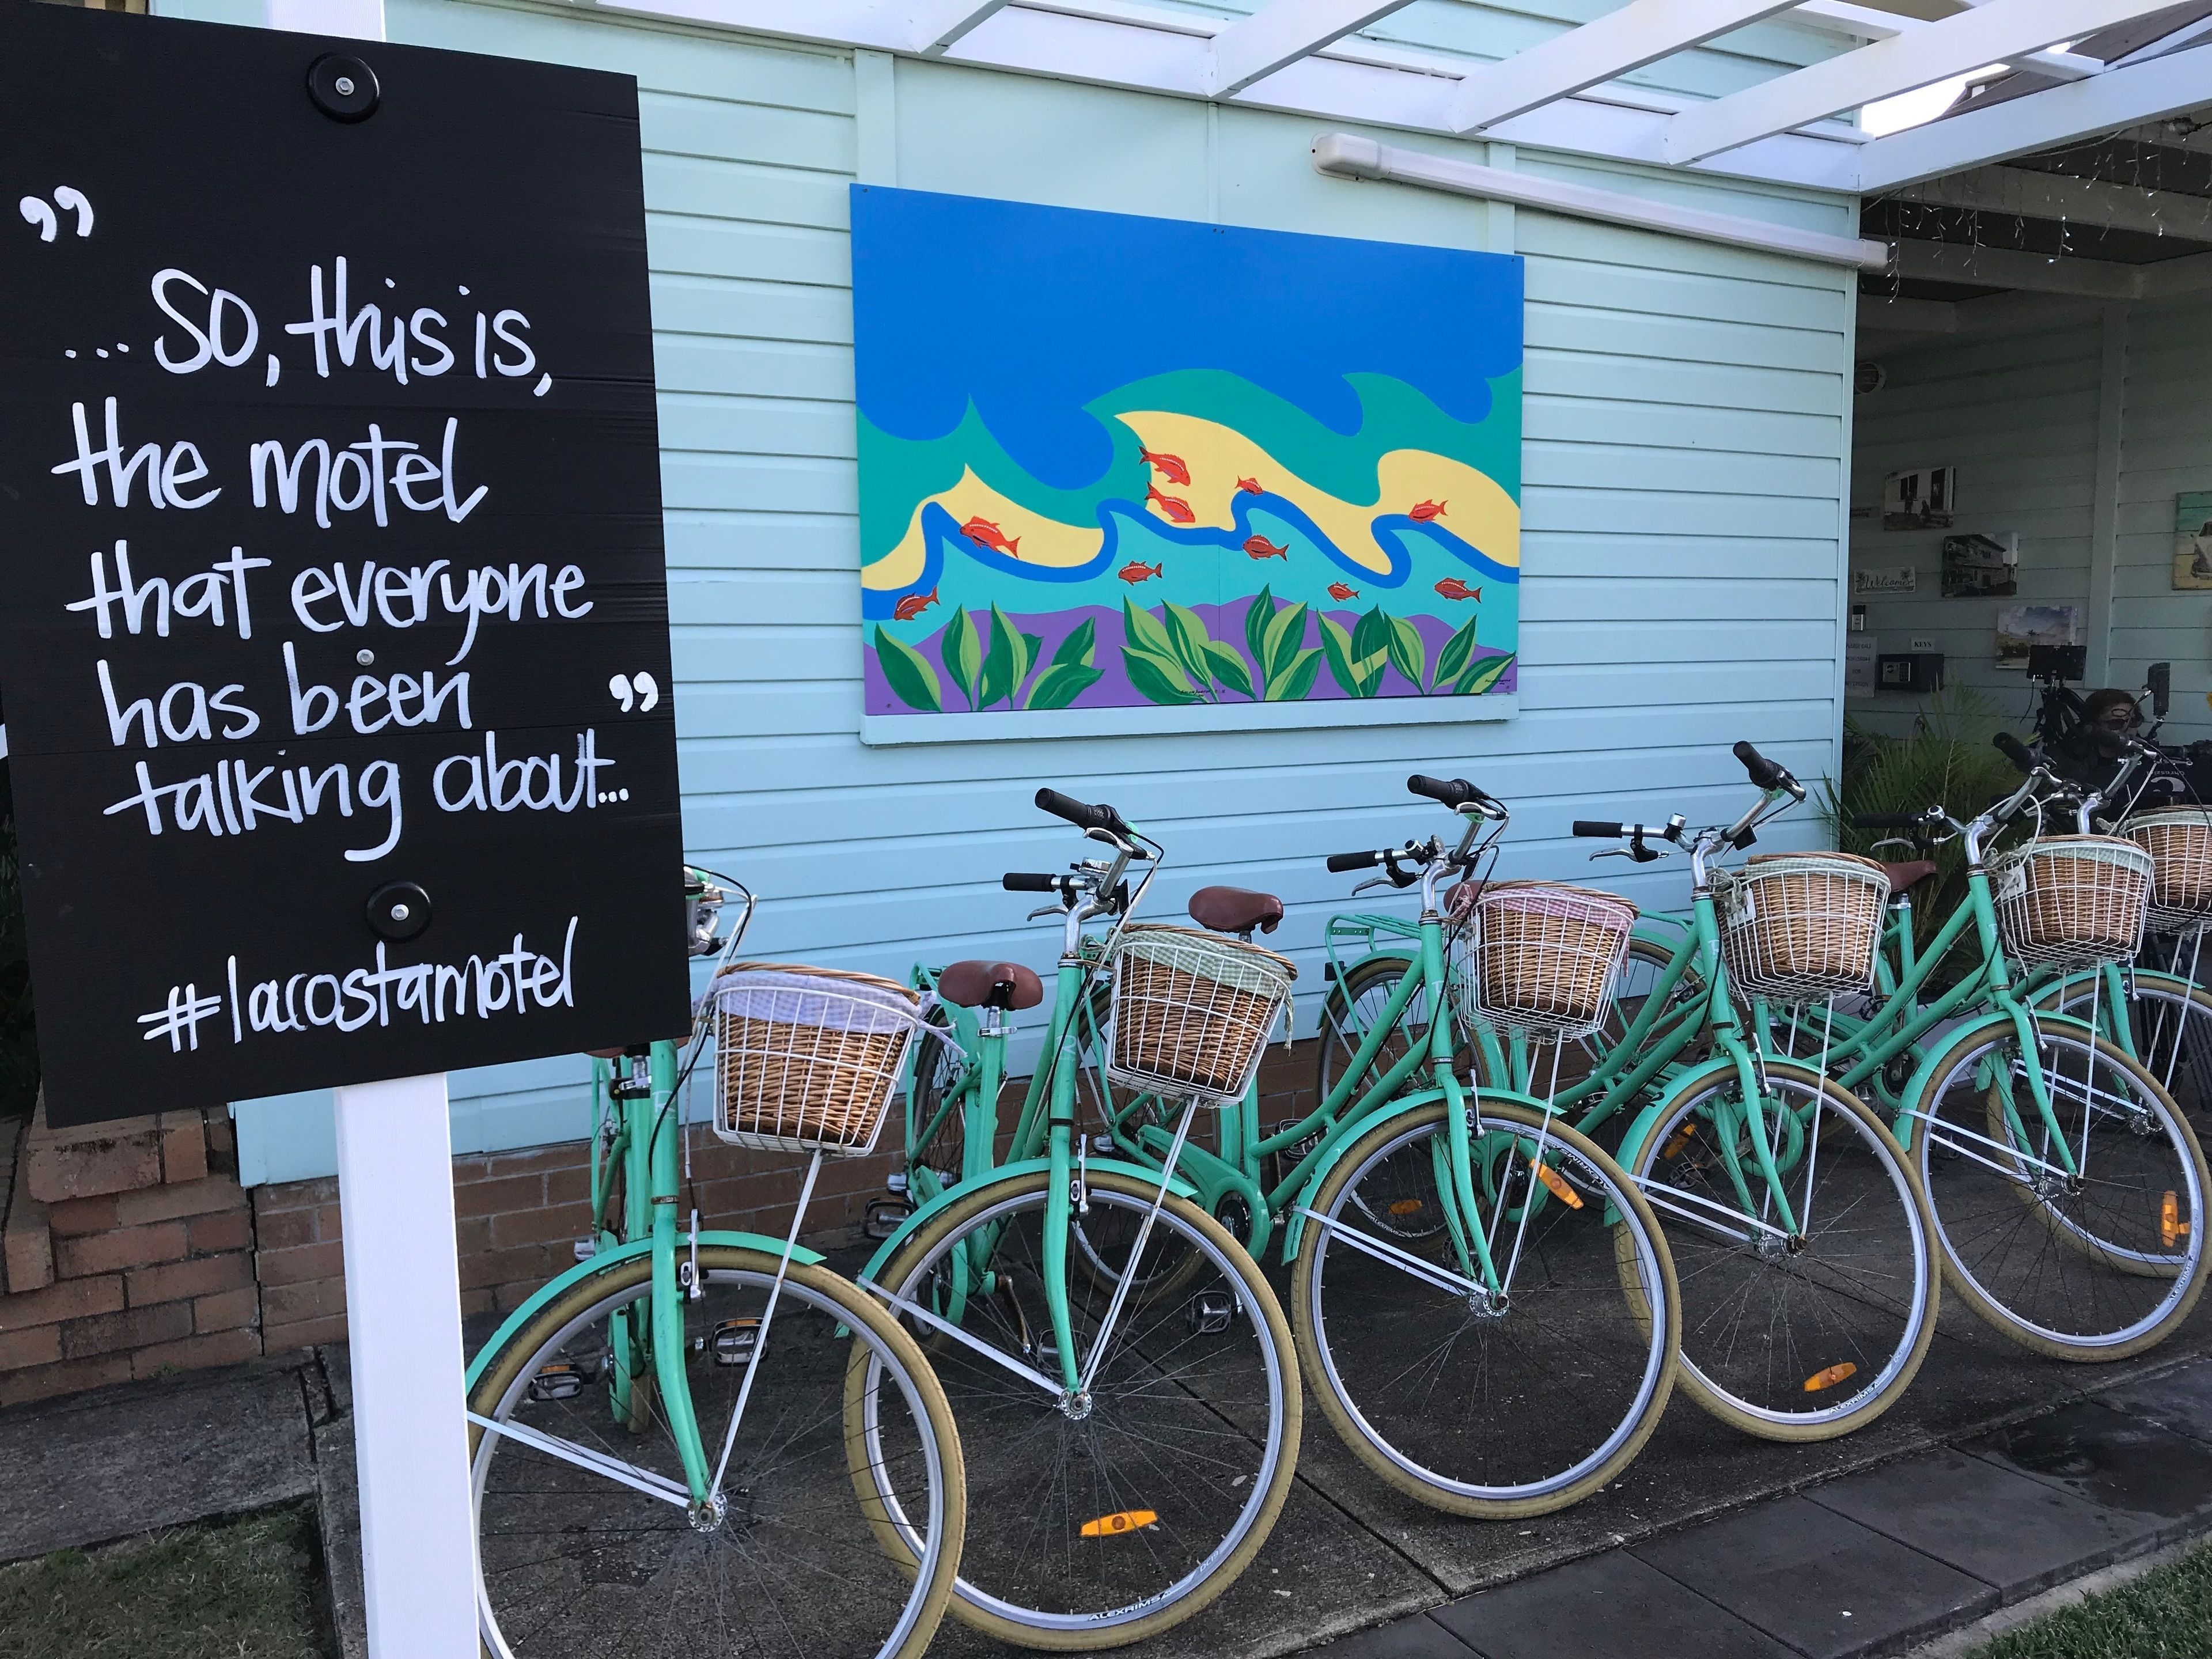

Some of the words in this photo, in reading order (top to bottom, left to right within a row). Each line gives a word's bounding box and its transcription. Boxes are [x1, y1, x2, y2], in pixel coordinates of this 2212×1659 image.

[284, 255, 456, 387] this
[458, 285, 554, 397] is,
[51, 396, 222, 510] the
[249, 416, 490, 529] motel
[63, 539, 273, 640] that
[290, 559, 594, 666] everyone
[1863, 574, 1909, 590] Welcome
[96, 658, 261, 749] has
[282, 641, 473, 736] been
[102, 749, 403, 862] talking
[136, 915, 579, 1054] #lacostamotel
